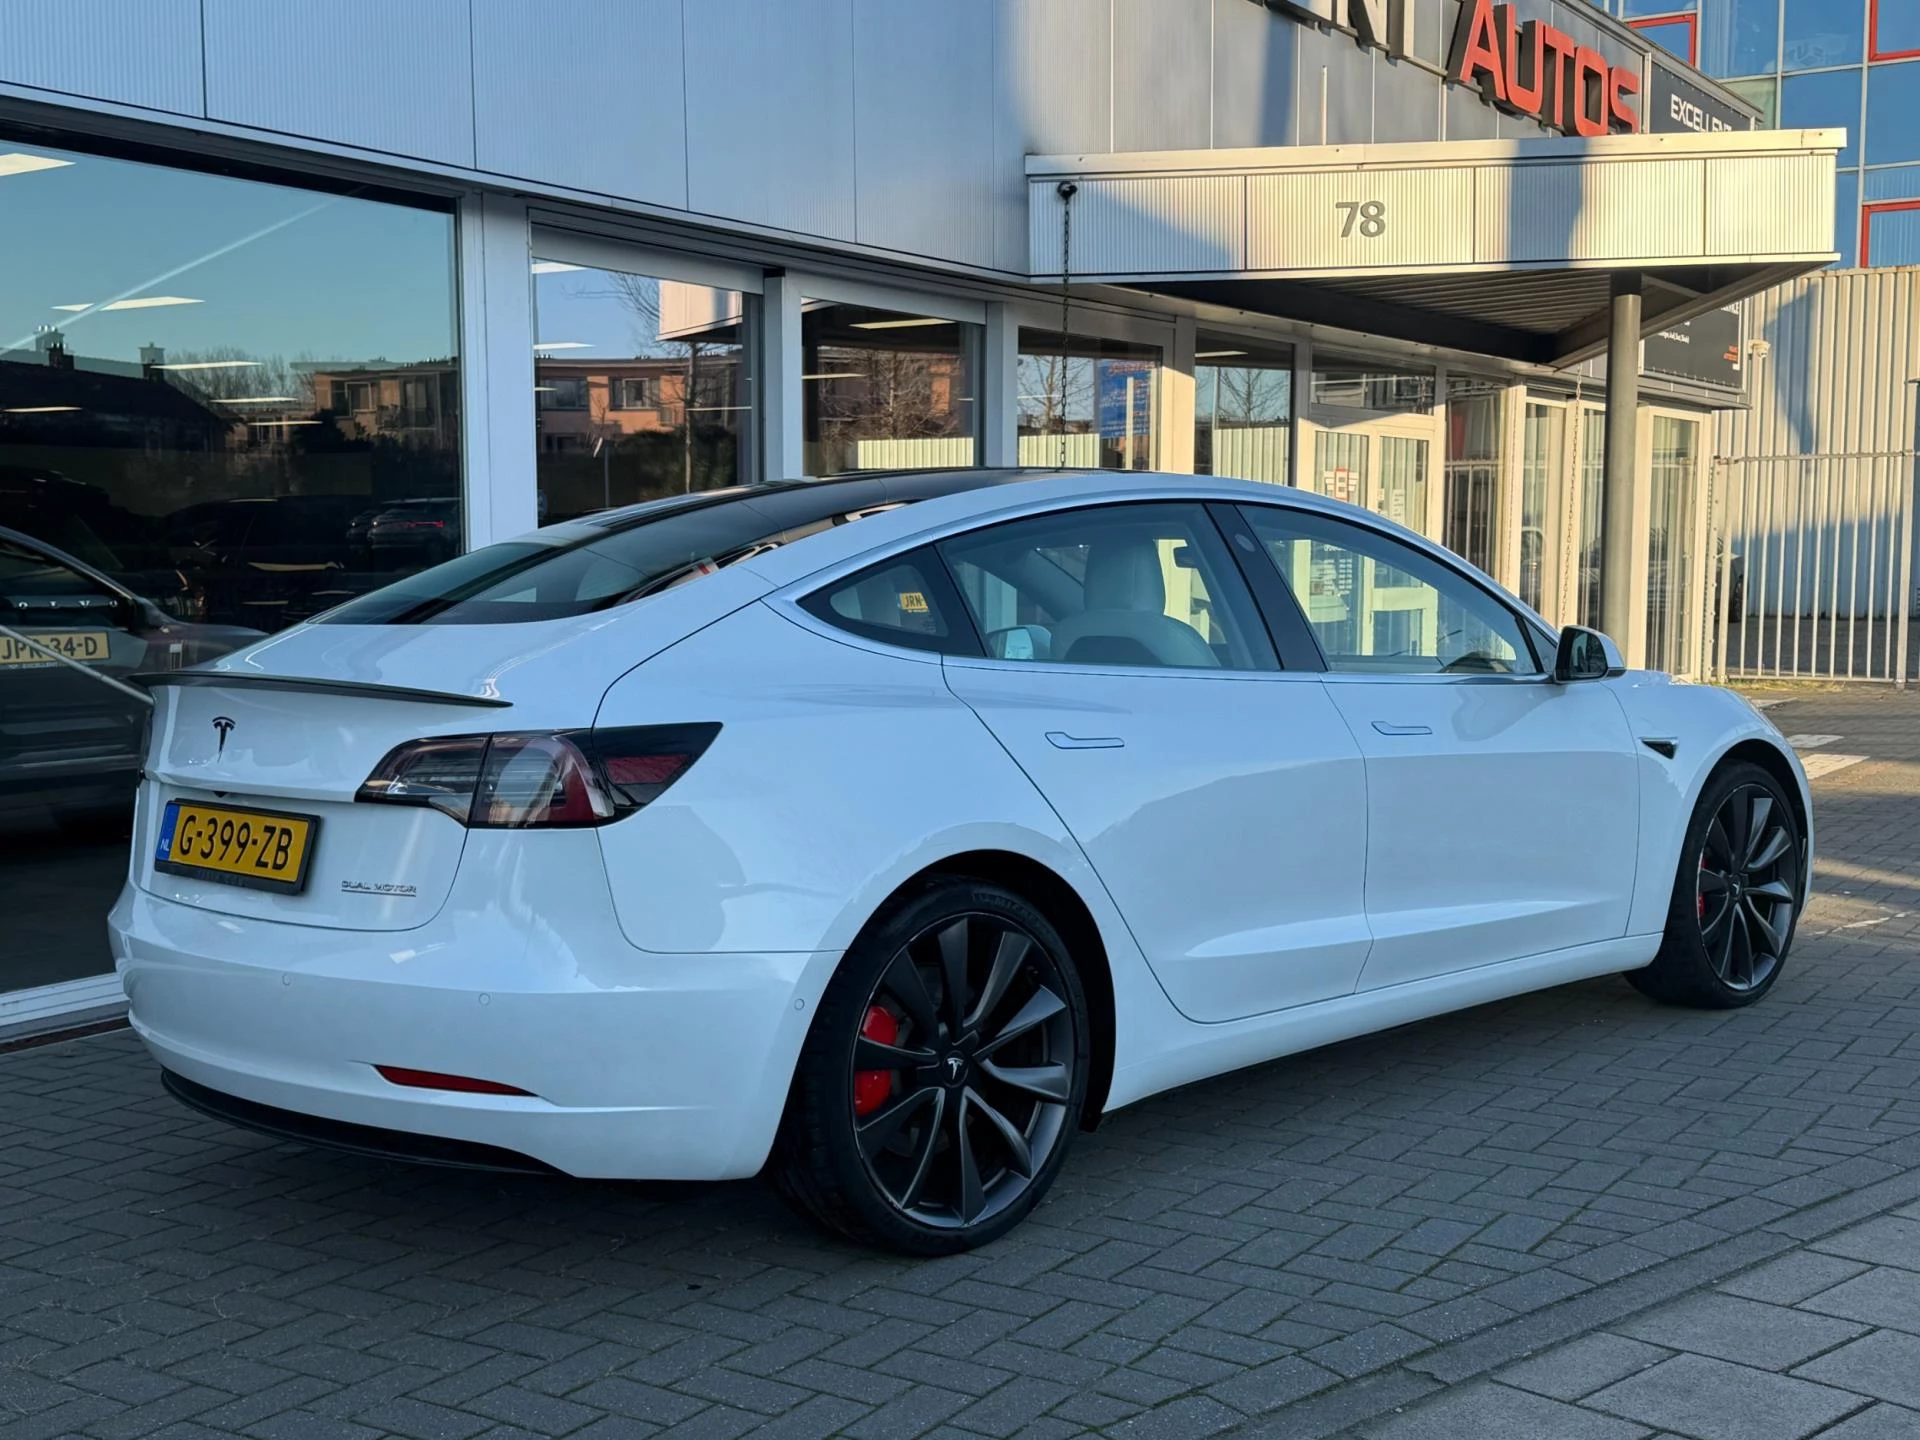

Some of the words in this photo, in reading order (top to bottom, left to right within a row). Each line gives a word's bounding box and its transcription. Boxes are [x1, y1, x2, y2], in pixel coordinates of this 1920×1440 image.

[1458, 0, 1639, 137] AUTOS
[1335, 200, 1386, 238] 78
[160, 838, 170, 852] NL
[179, 814, 293, 871] G-399-ZB
[341, 880, 371, 890] DUAL
[374, 883, 417, 893] MOTOR
